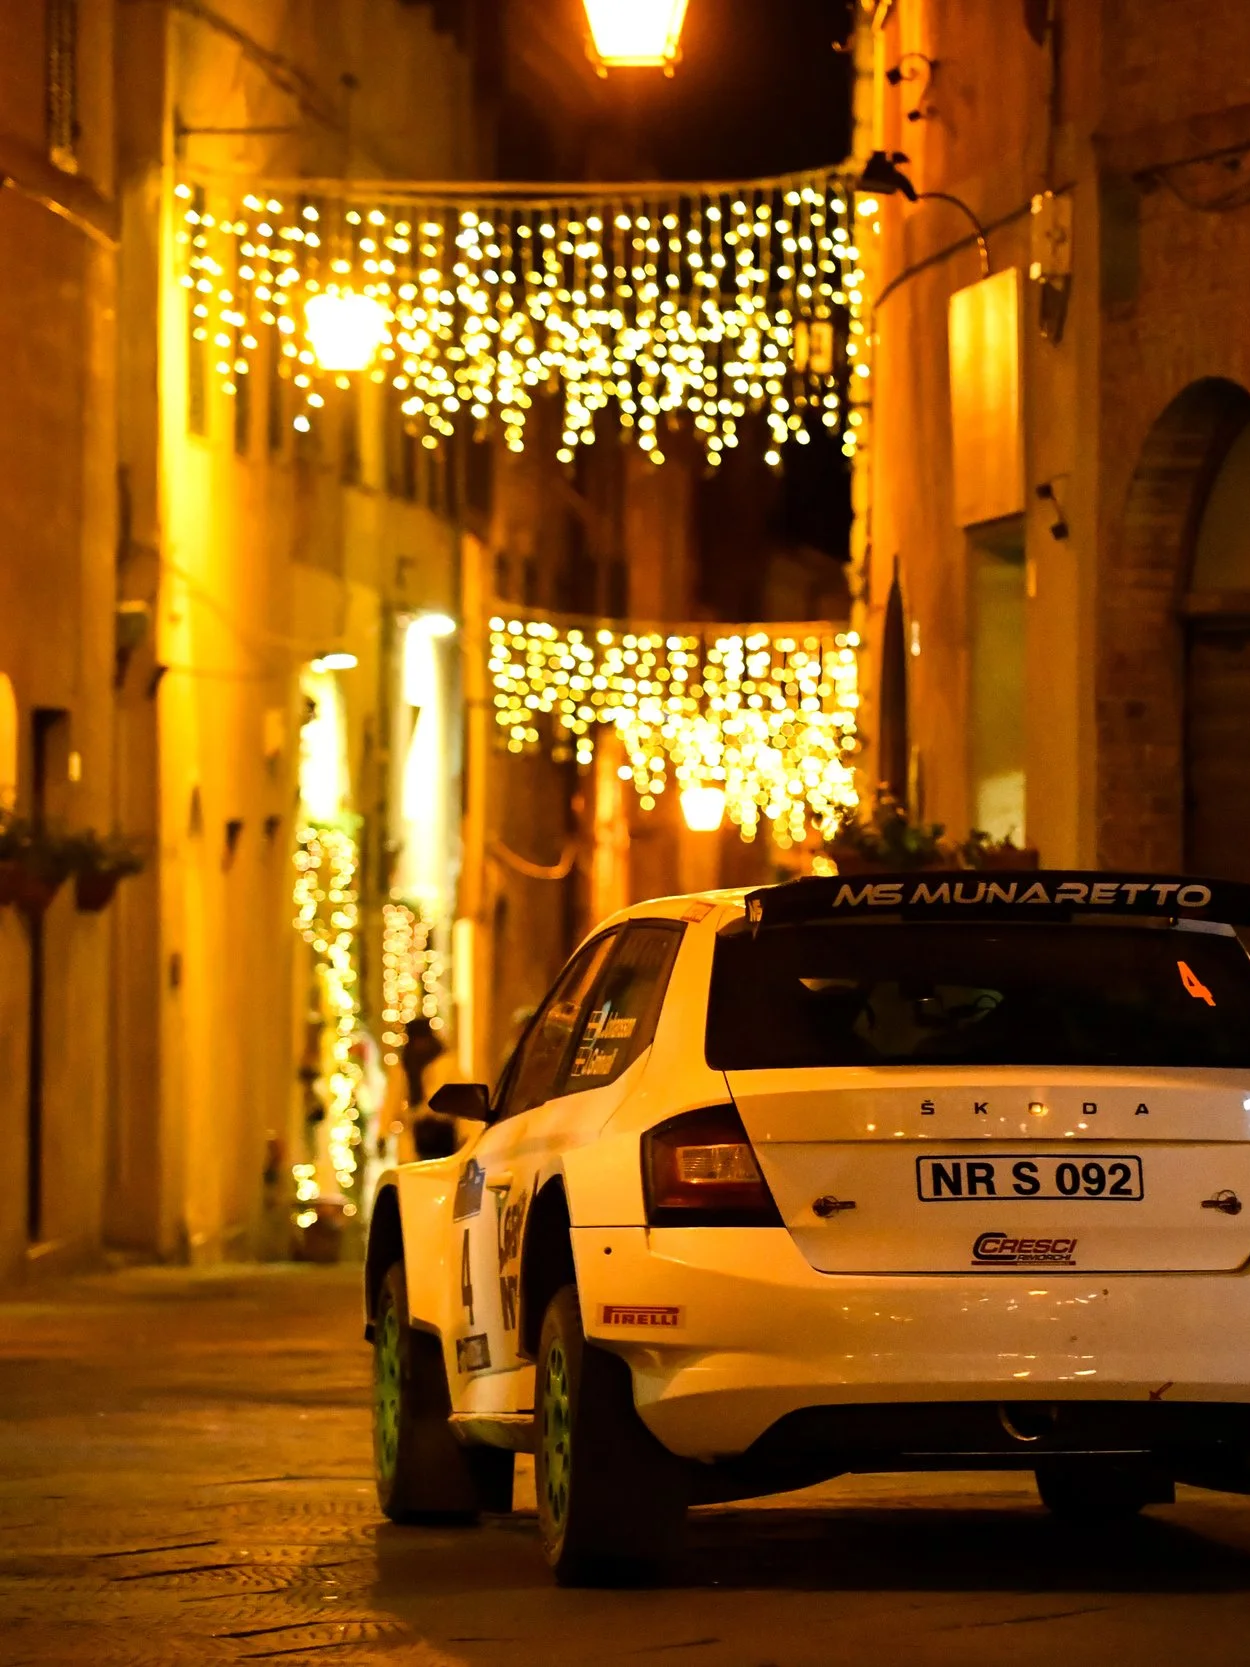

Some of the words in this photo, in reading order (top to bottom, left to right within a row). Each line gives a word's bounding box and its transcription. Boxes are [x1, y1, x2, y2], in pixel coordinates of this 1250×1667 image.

[832, 882, 904, 908] MS
[908, 881, 1212, 908] MUNARETTO
[1176, 960, 1216, 1007] 4
[931, 1162, 996, 1196] NR
[1012, 1161, 1041, 1196] S
[1055, 1162, 1133, 1196] 092
[603, 1305, 679, 1326] PIRELLI
